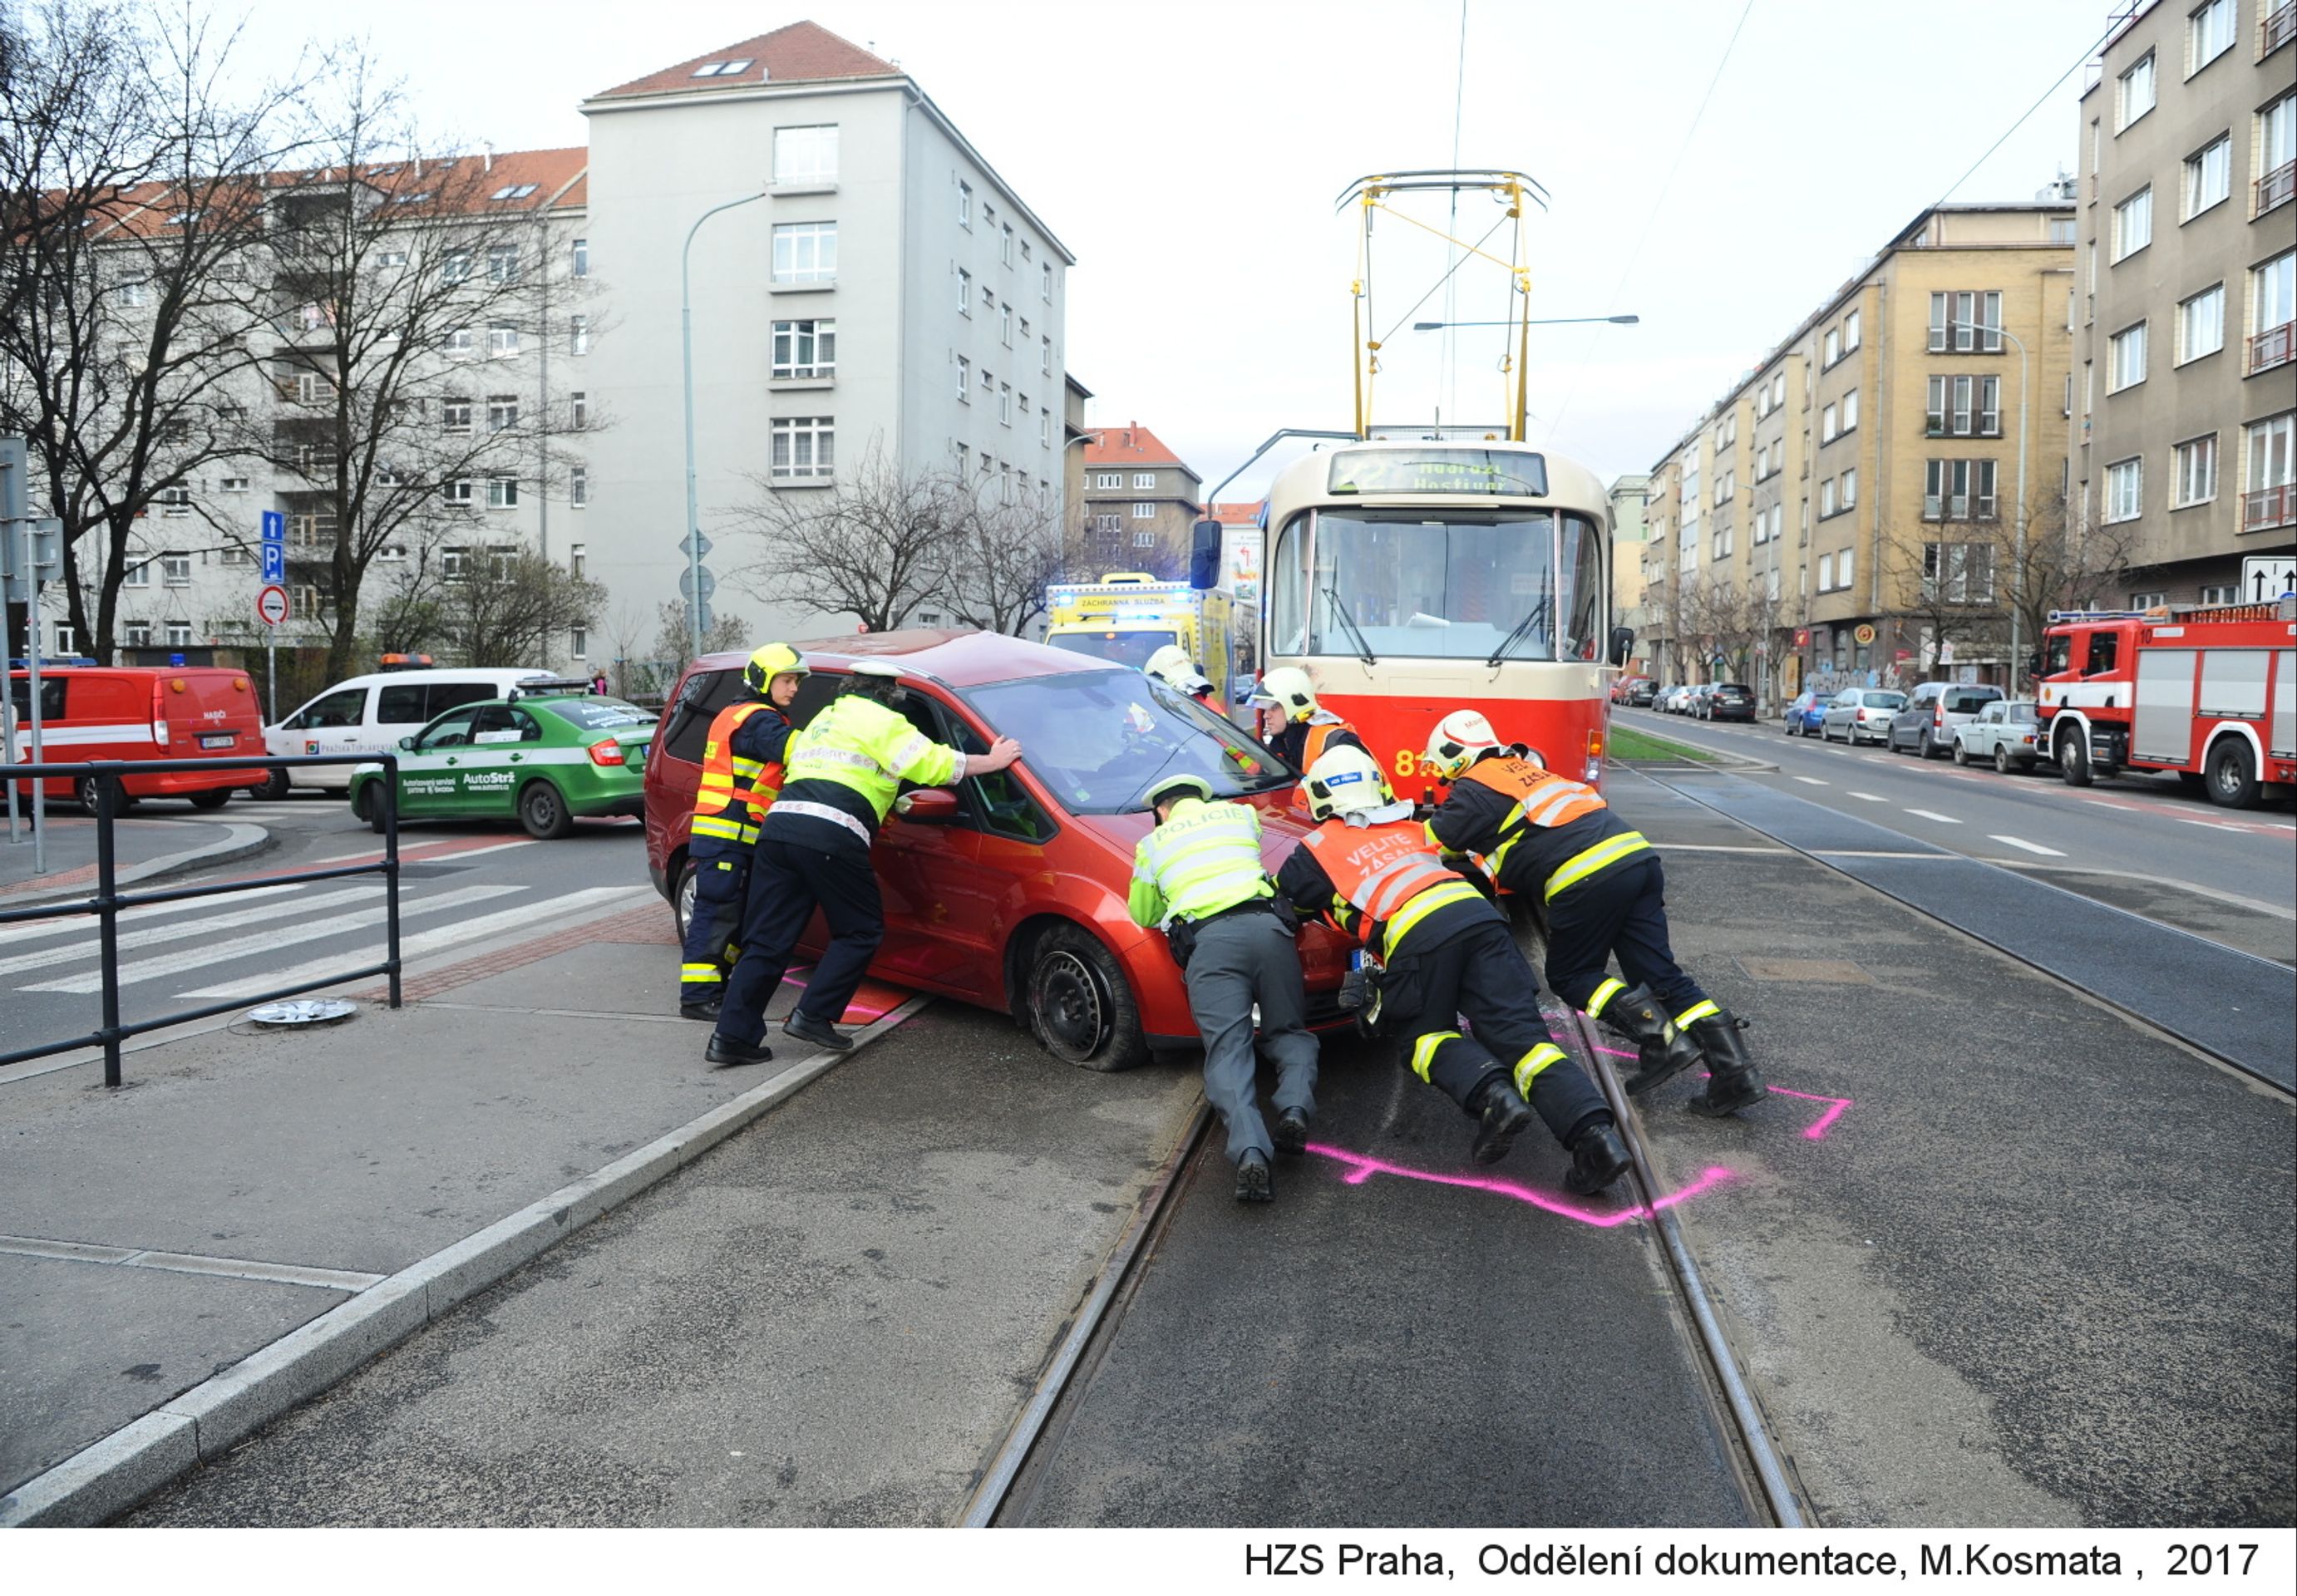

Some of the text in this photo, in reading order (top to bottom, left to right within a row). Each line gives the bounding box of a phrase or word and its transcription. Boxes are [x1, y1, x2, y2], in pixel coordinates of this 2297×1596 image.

[266, 547, 278, 570] P
[2140, 628, 2152, 644] 10
[463, 771, 515, 785] AutoStrž
[1156, 806, 1245, 842] POLICIE
